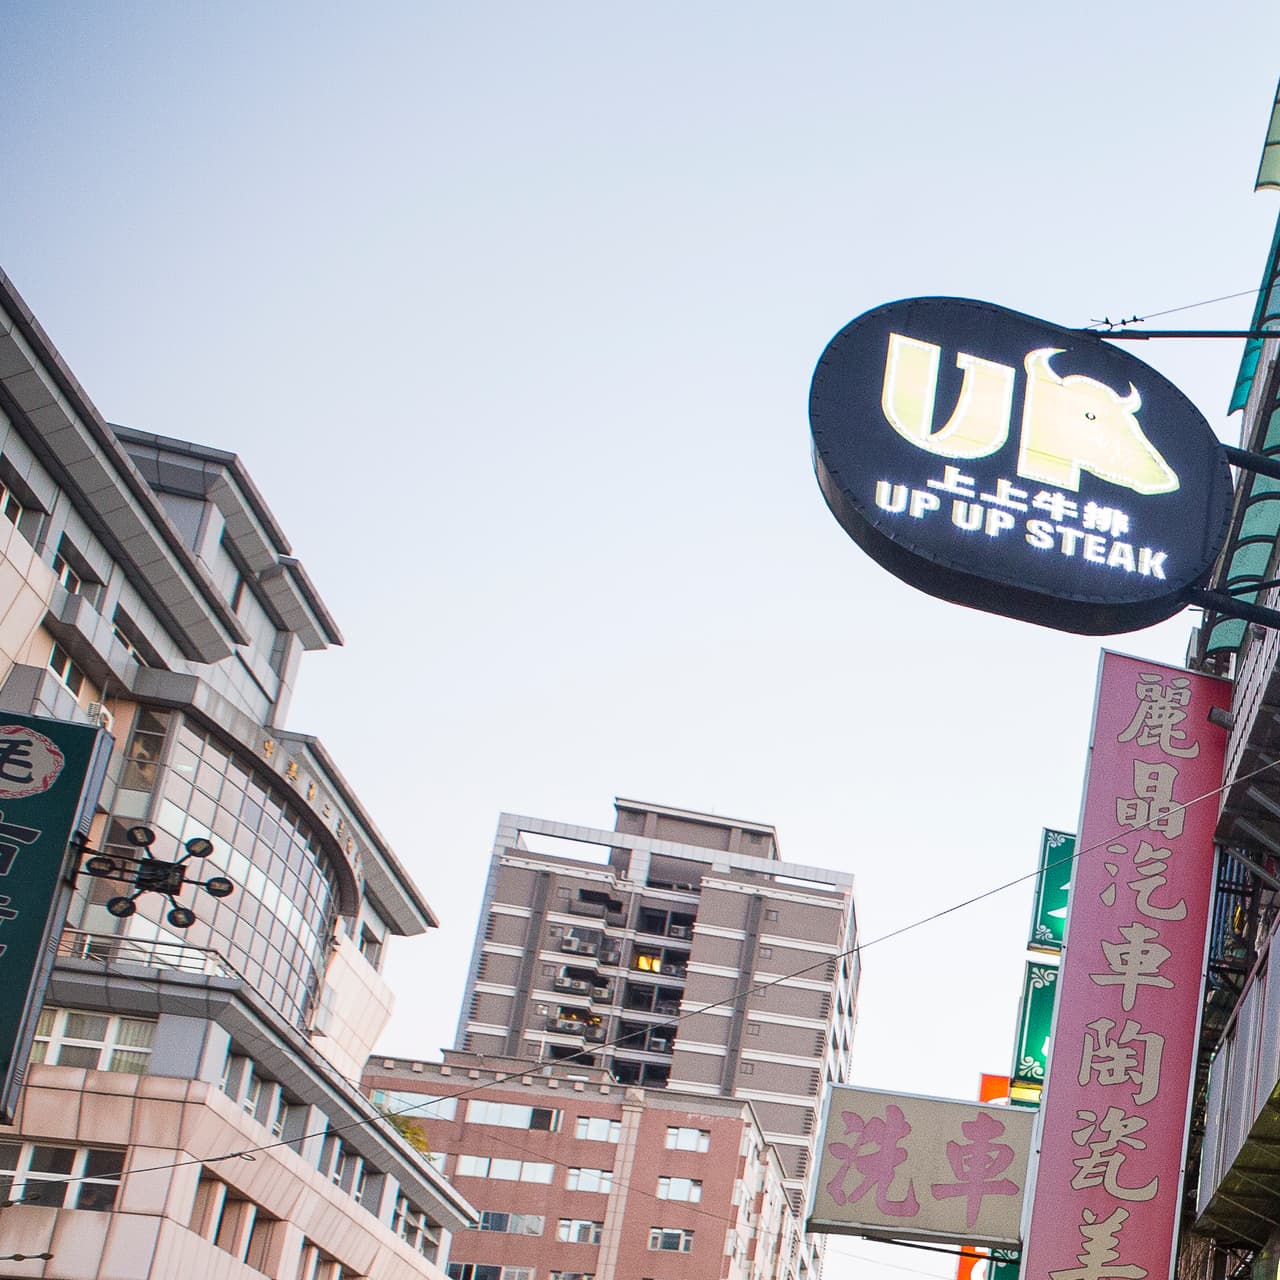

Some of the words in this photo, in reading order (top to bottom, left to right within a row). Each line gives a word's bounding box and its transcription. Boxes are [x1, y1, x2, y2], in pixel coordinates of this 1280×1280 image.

[876, 480, 941, 519] UP
[951, 499, 1017, 539] UP
[1024, 518, 1168, 580] STEAK
[927, 465, 1130, 536] 上上牛排
[827, 1104, 1020, 1230] 洗車
